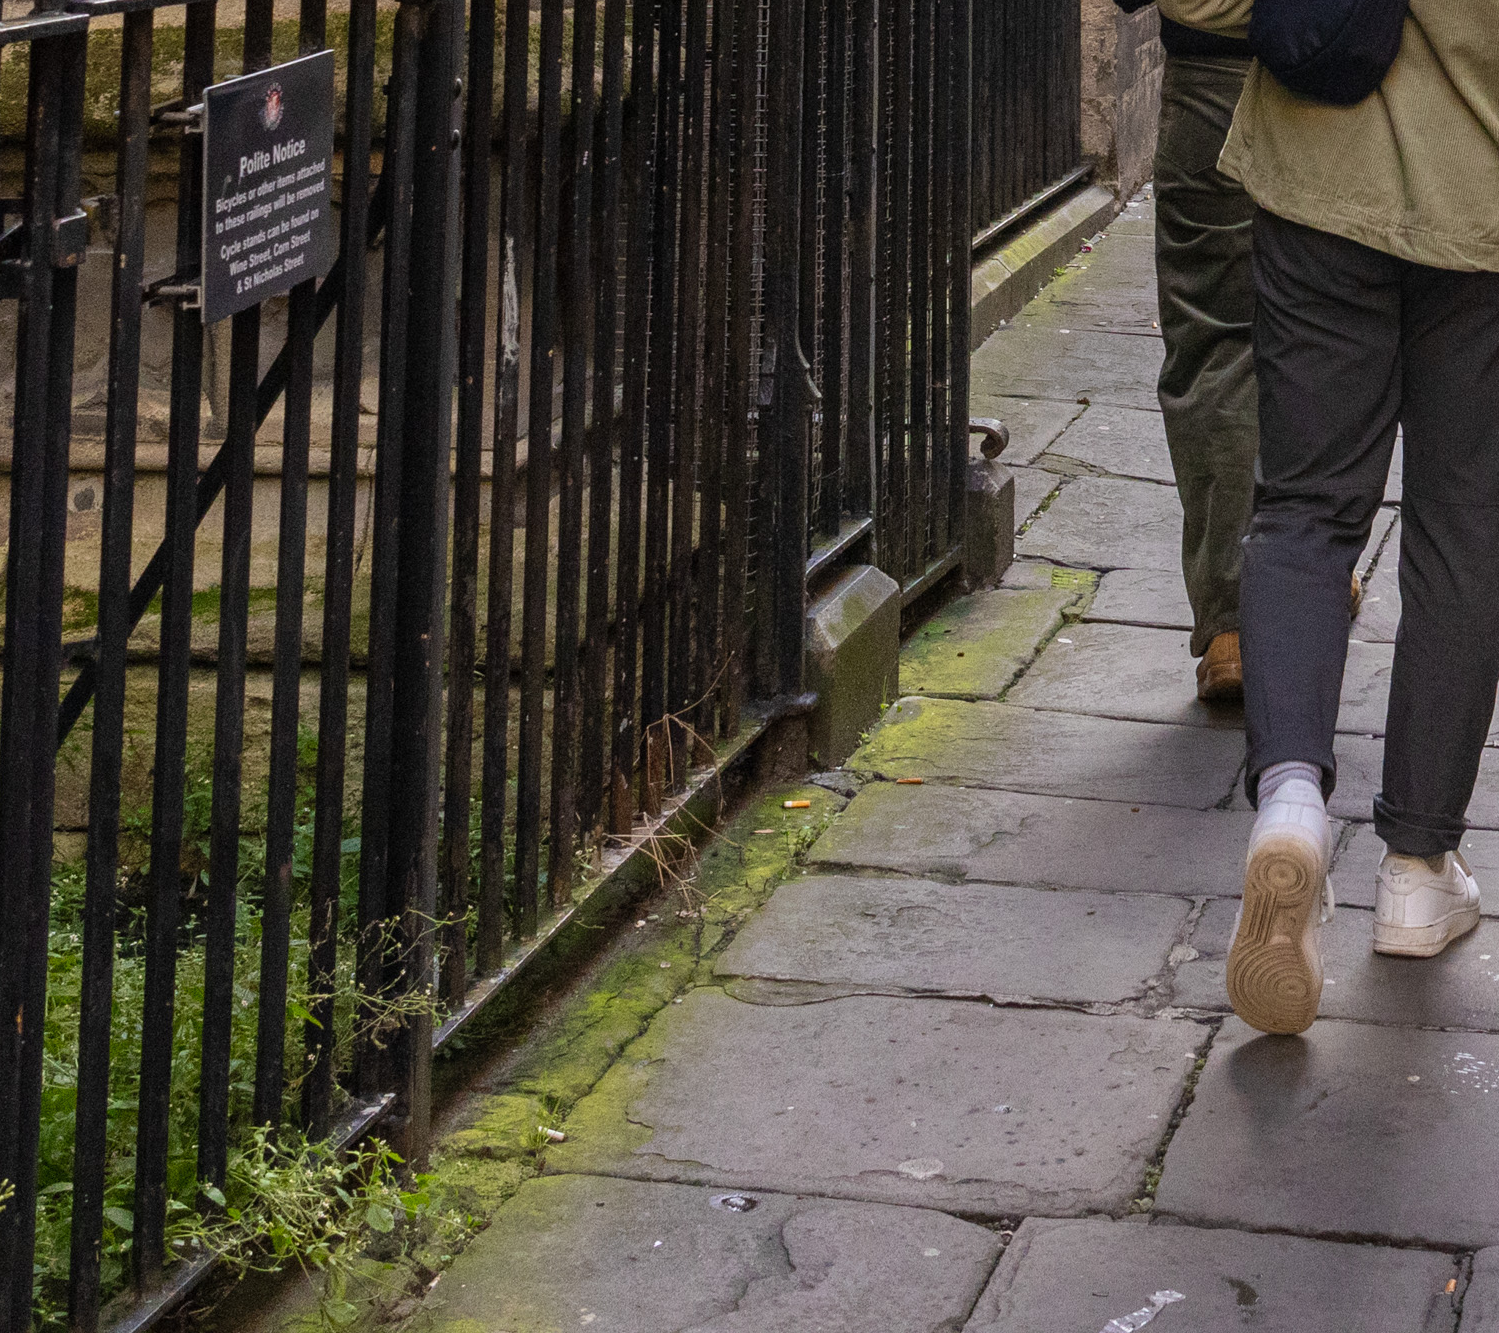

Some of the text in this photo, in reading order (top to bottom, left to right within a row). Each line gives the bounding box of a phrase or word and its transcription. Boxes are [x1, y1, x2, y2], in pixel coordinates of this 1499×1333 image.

[239, 138, 306, 178] Polite Notice
[216, 158, 325, 213] Bicycles or other items attached
[216, 177, 325, 235] to these railings will be removed
[221, 208, 320, 261] Cycle stands can be found on
[229, 260, 248, 276] Wine
[290, 229, 311, 249] Street
[236, 251, 304, 294] & St Nicholas Street
